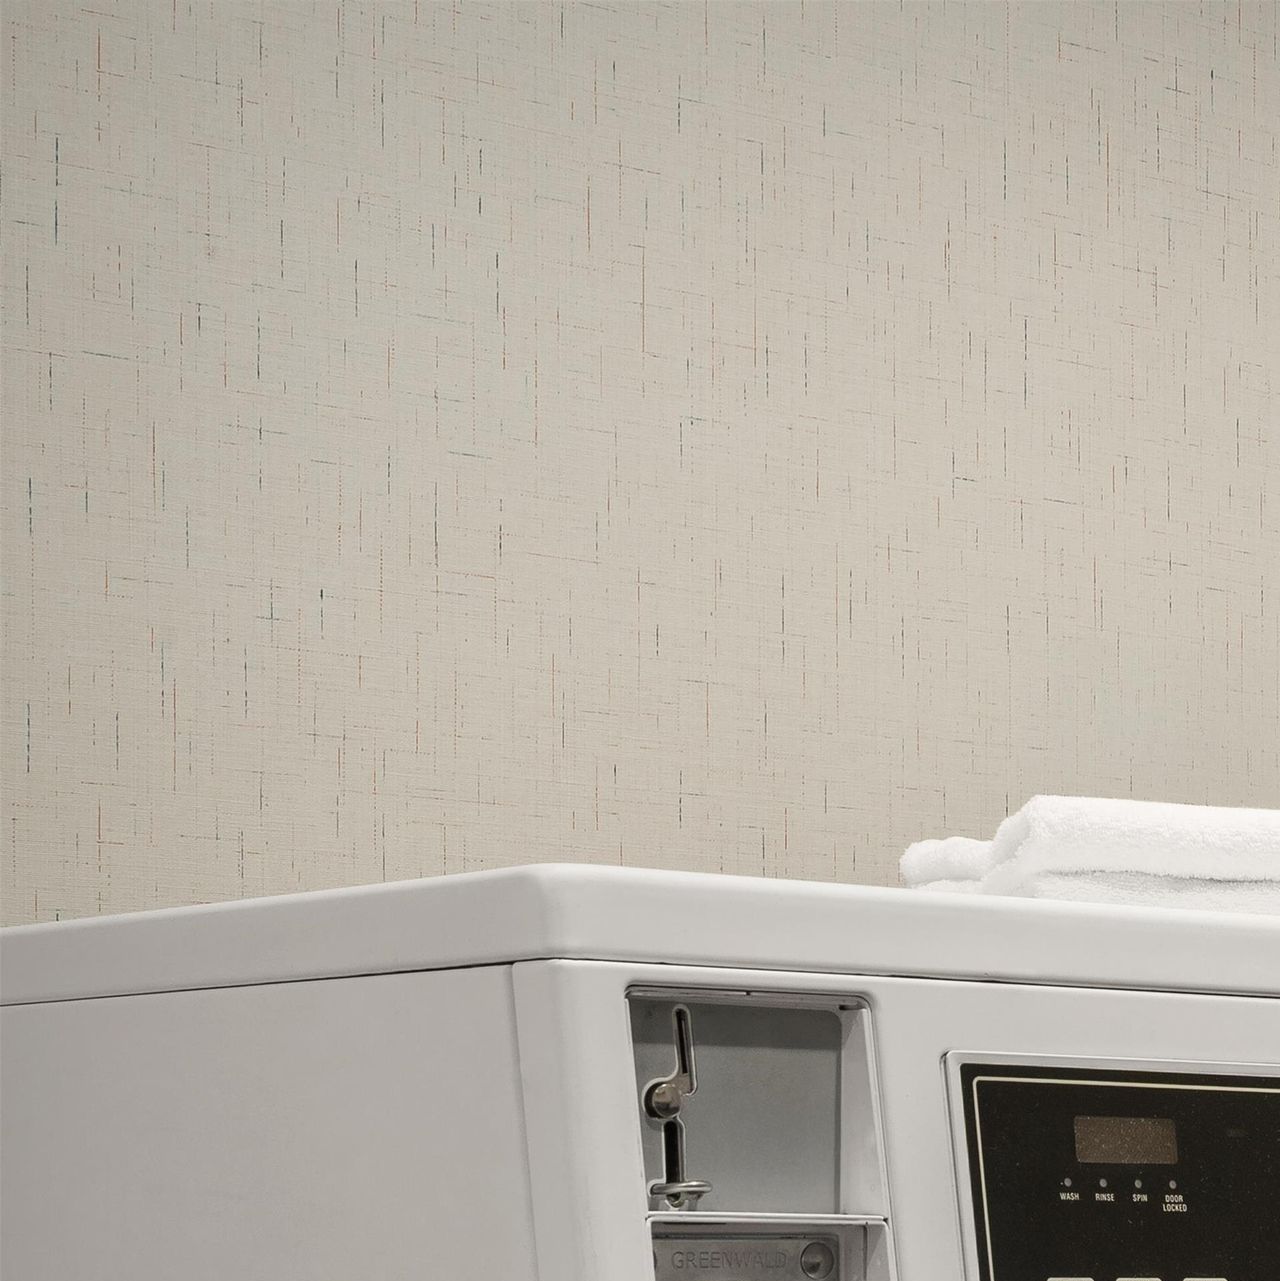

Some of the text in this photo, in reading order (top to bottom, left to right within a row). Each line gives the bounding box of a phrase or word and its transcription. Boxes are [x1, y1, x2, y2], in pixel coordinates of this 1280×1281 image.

[1059, 1192, 1080, 1201] WASH
[1095, 1193, 1115, 1201] RINSE
[1132, 1193, 1148, 1202] SPIN
[1165, 1194, 1184, 1203] DOOR
[1162, 1203, 1188, 1212] LOCKED
[671, 1251, 787, 1269] GREENWALD
